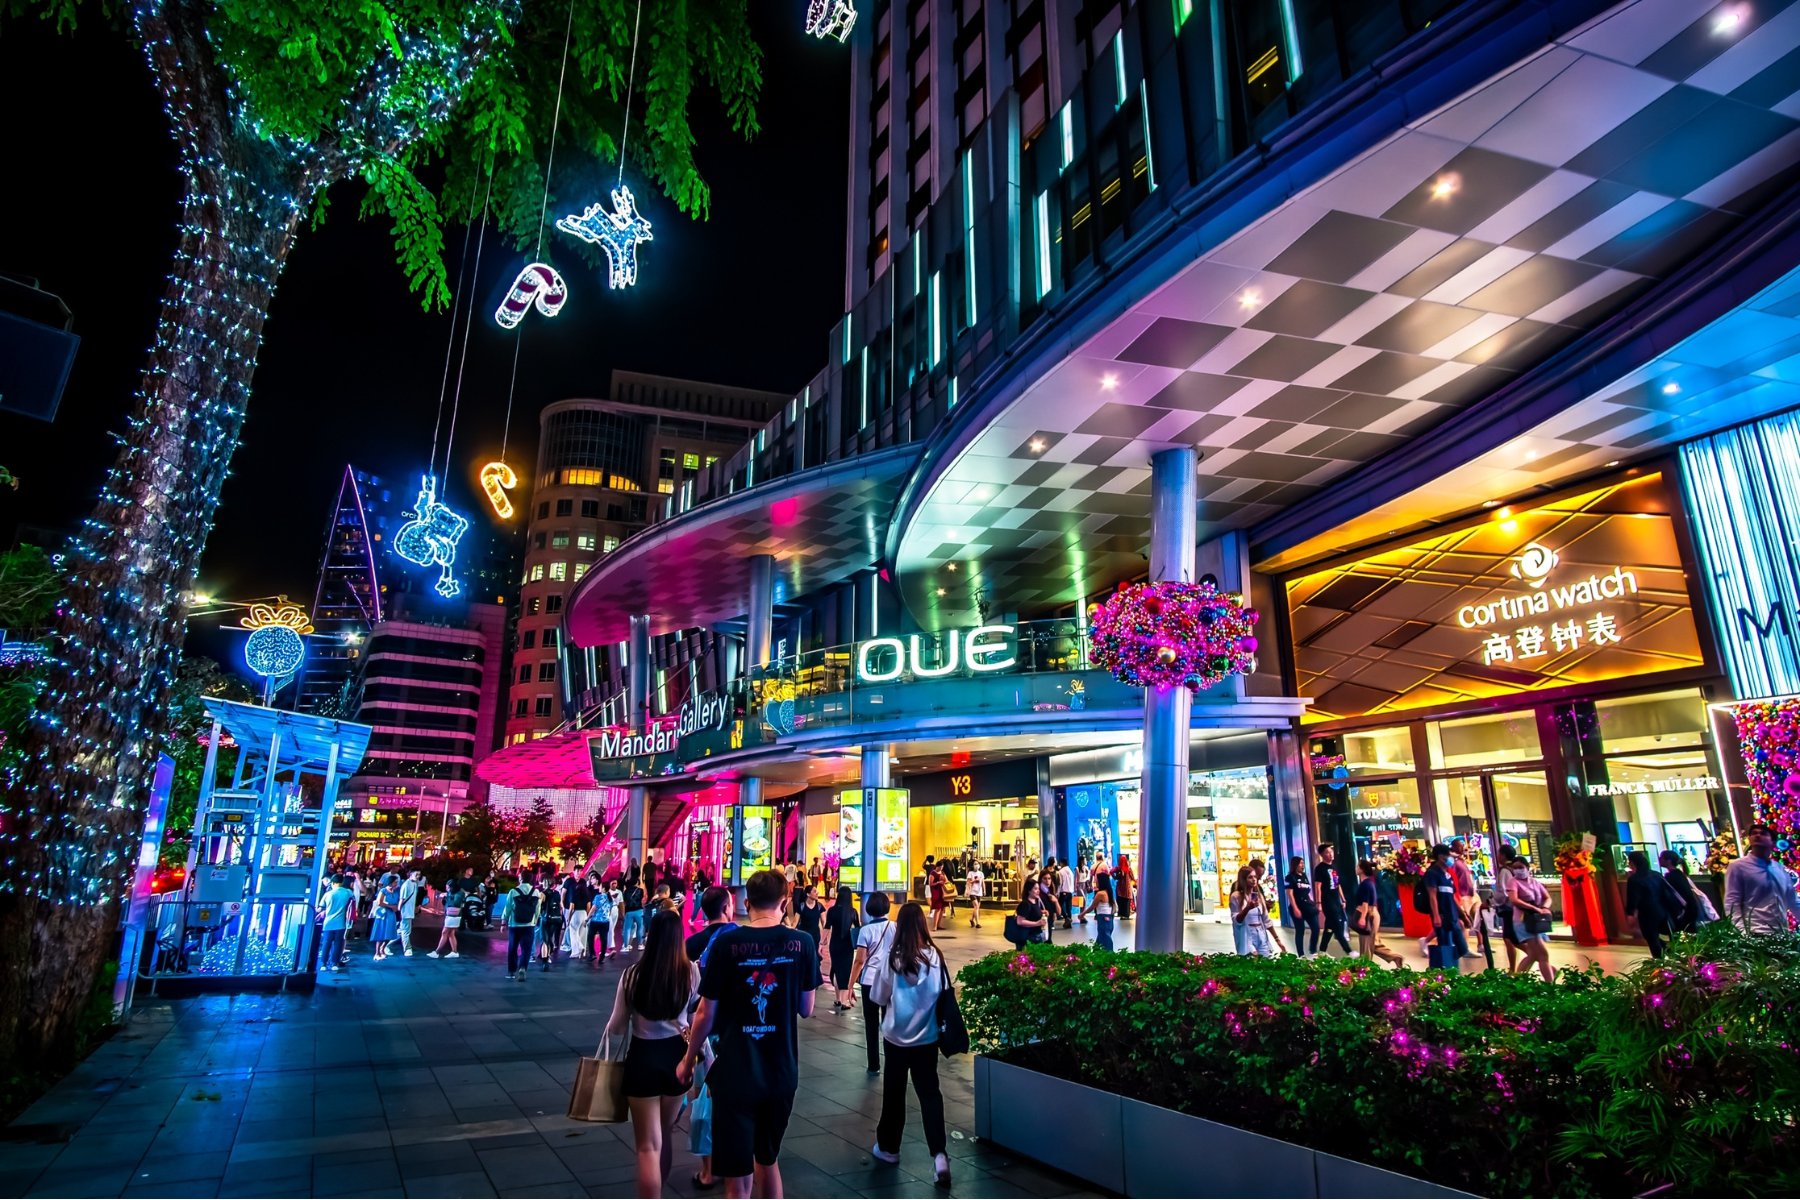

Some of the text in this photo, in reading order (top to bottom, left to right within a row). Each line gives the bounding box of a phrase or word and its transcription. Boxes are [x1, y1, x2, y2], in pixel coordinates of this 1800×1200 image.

[1458, 566, 1638, 629] cortina watch
[859, 624, 1016, 682] OUE
[1482, 611, 1622, 666] 高登钟表
[600, 694, 729, 759] Mandari Gallery
[1354, 806, 1398, 820] TUDOR
[1587, 781, 1650, 797] FRANCK
